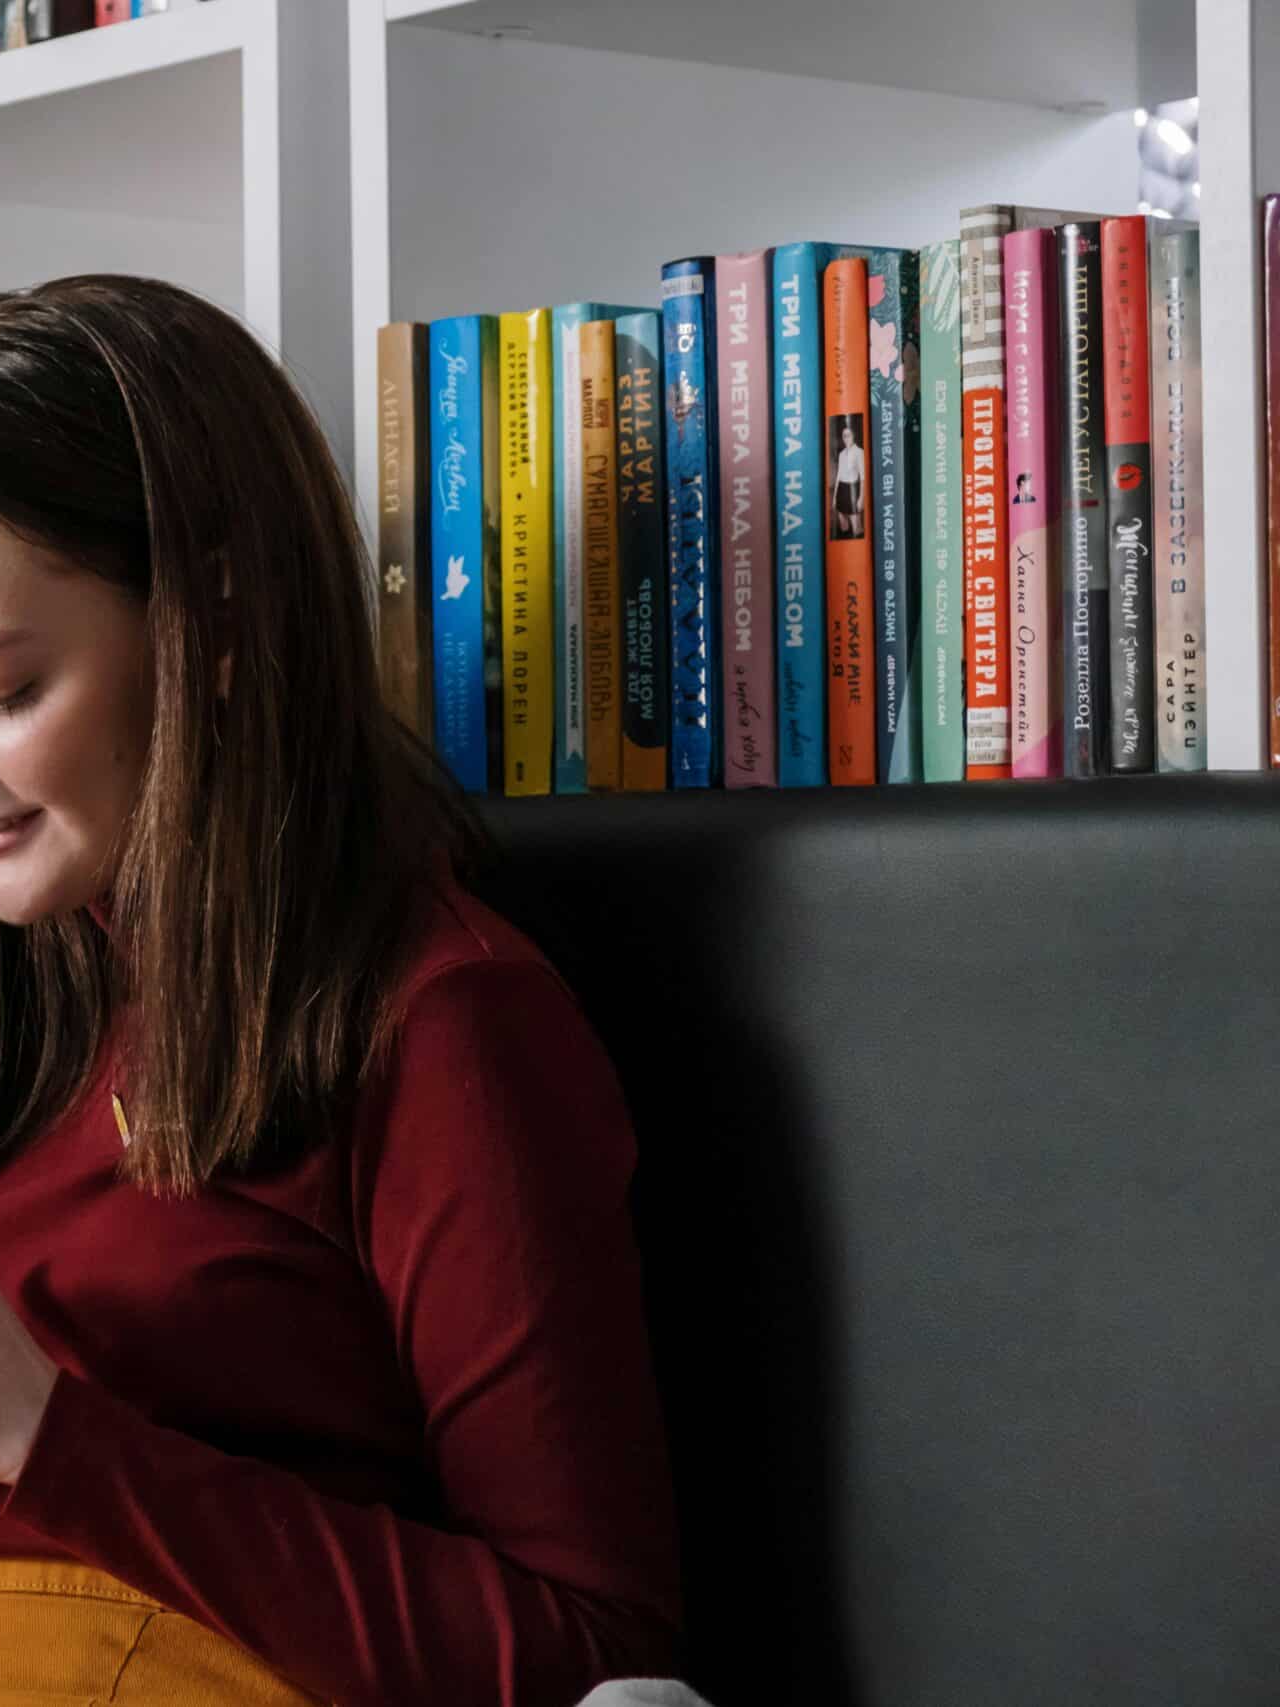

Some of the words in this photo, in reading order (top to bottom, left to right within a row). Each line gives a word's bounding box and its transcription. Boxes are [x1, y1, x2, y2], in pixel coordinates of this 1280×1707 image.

[729, 281, 750, 346] ТРИ
[781, 273, 802, 338] ТРИ
[581, 377, 595, 430] МАРЛОУ
[729, 359, 751, 464] МЕТРА
[783, 351, 803, 458] МЕТРА
[1070, 264, 1094, 494] ДЕГУСТАТОРШИ
[618, 373, 635, 503] ЧАРЛЬЗ
[634, 367, 655, 505] МАРТИН
[1167, 383, 1186, 567] ЗАЗЕРКАЛЬЕ
[731, 476, 752, 542] НАД
[782, 469, 804, 537] НАД
[973, 396, 998, 563] ПРОКЛЯТИЕ
[586, 453, 613, 618] СУМАСШЕДШАЯ
[883, 503, 895, 553] ЭТОМ
[513, 513, 528, 637] КРИСТИНА
[733, 548, 753, 652] НЕБОМ
[785, 543, 804, 649] НЕБОМ
[884, 559, 897, 582] ОБ
[934, 578, 948, 635] ПУСТЬ
[1016, 546, 1036, 615] Ханна
[1072, 517, 1093, 638] Посторино
[1170, 578, 1187, 595] В
[626, 598, 638, 664] ЖИВЕТ
[639, 577, 654, 669] ЛЮБОВЬ
[847, 581, 863, 660] СКАЖИ
[884, 588, 897, 643] НИКТО
[974, 575, 998, 699] СВИТЕРА
[513, 650, 528, 726] ЛОРЕН
[590, 629, 614, 722] ЛЮБОВЬ
[627, 671, 640, 704] ГДЕ
[640, 672, 655, 720] МОЯ
[831, 663, 845, 678] Я
[1015, 625, 1037, 746] Оренстейн
[1073, 644, 1091, 730] Розелла
[1165, 660, 1176, 724] САРА
[1181, 633, 1197, 749] ПЭЙНТЕР
